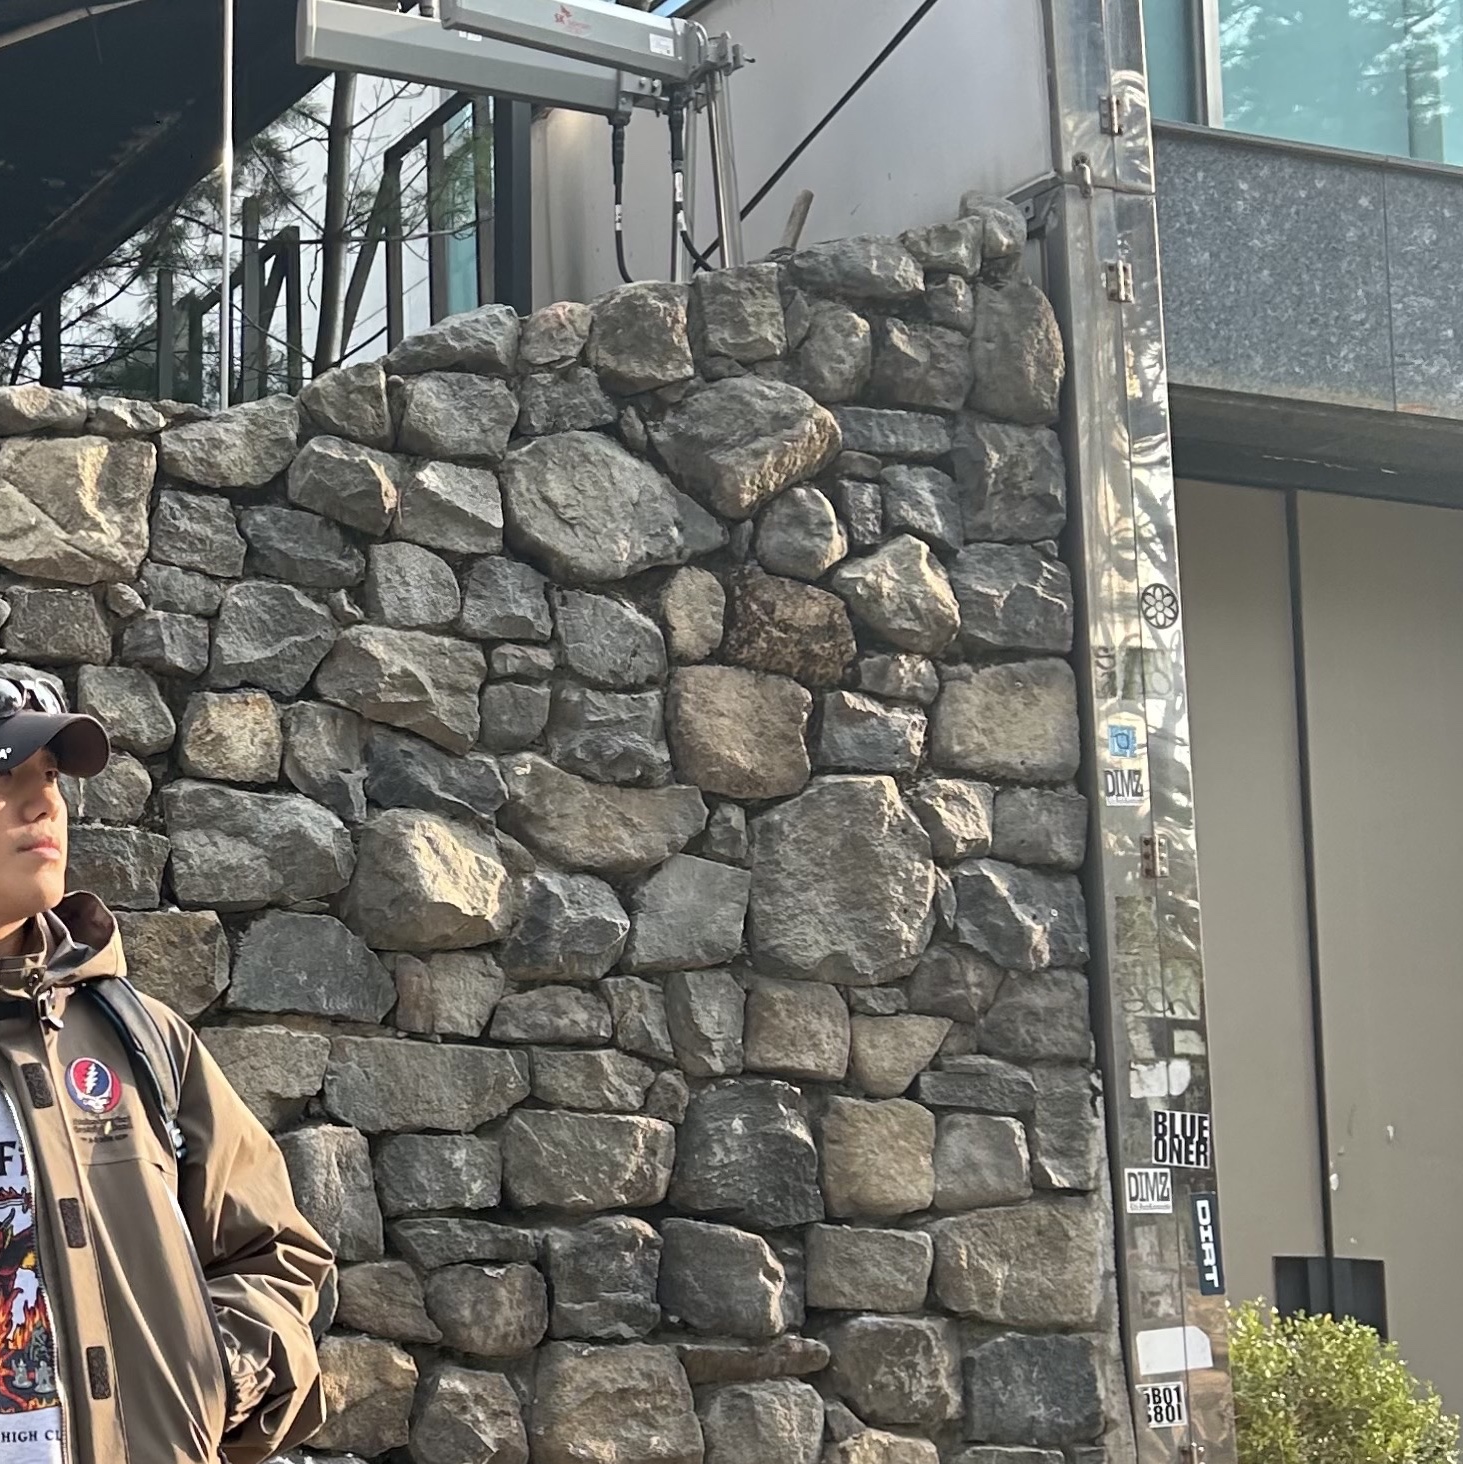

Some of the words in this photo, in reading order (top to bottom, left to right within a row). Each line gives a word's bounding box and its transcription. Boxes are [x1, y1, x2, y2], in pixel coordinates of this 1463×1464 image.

[1104, 769, 1144, 797] DIMZ
[1154, 1111, 1208, 1141] BLUE
[1154, 1137, 1208, 1168] ONER
[1127, 1172, 1171, 1202] DIMZ
[1196, 1199, 1220, 1288] DIRT
[1, 1430, 38, 1443] HIGH
